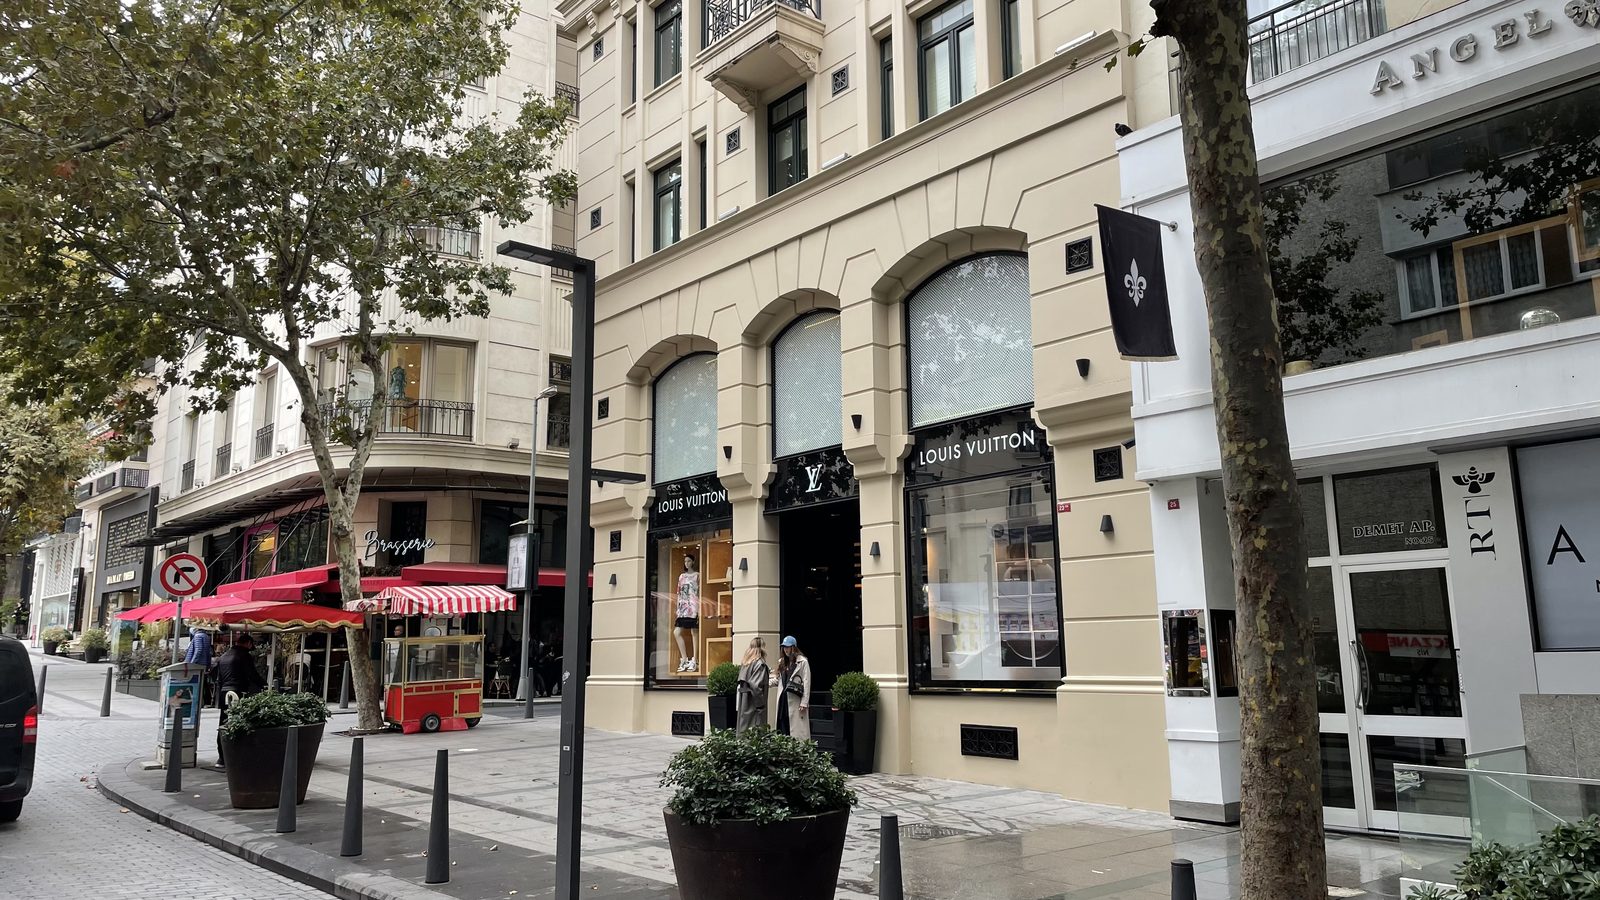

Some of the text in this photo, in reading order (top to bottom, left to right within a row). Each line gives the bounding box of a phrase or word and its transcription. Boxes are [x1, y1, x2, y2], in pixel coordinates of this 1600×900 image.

[1369, 8, 1553, 95] ANGEL
[920, 429, 1035, 465] LOUIS VUITTON
[658, 489, 726, 513] LOUIS VUITTON
[364, 529, 436, 560] Brasserie
[1352, 520, 1436, 538] DEMET AP.
